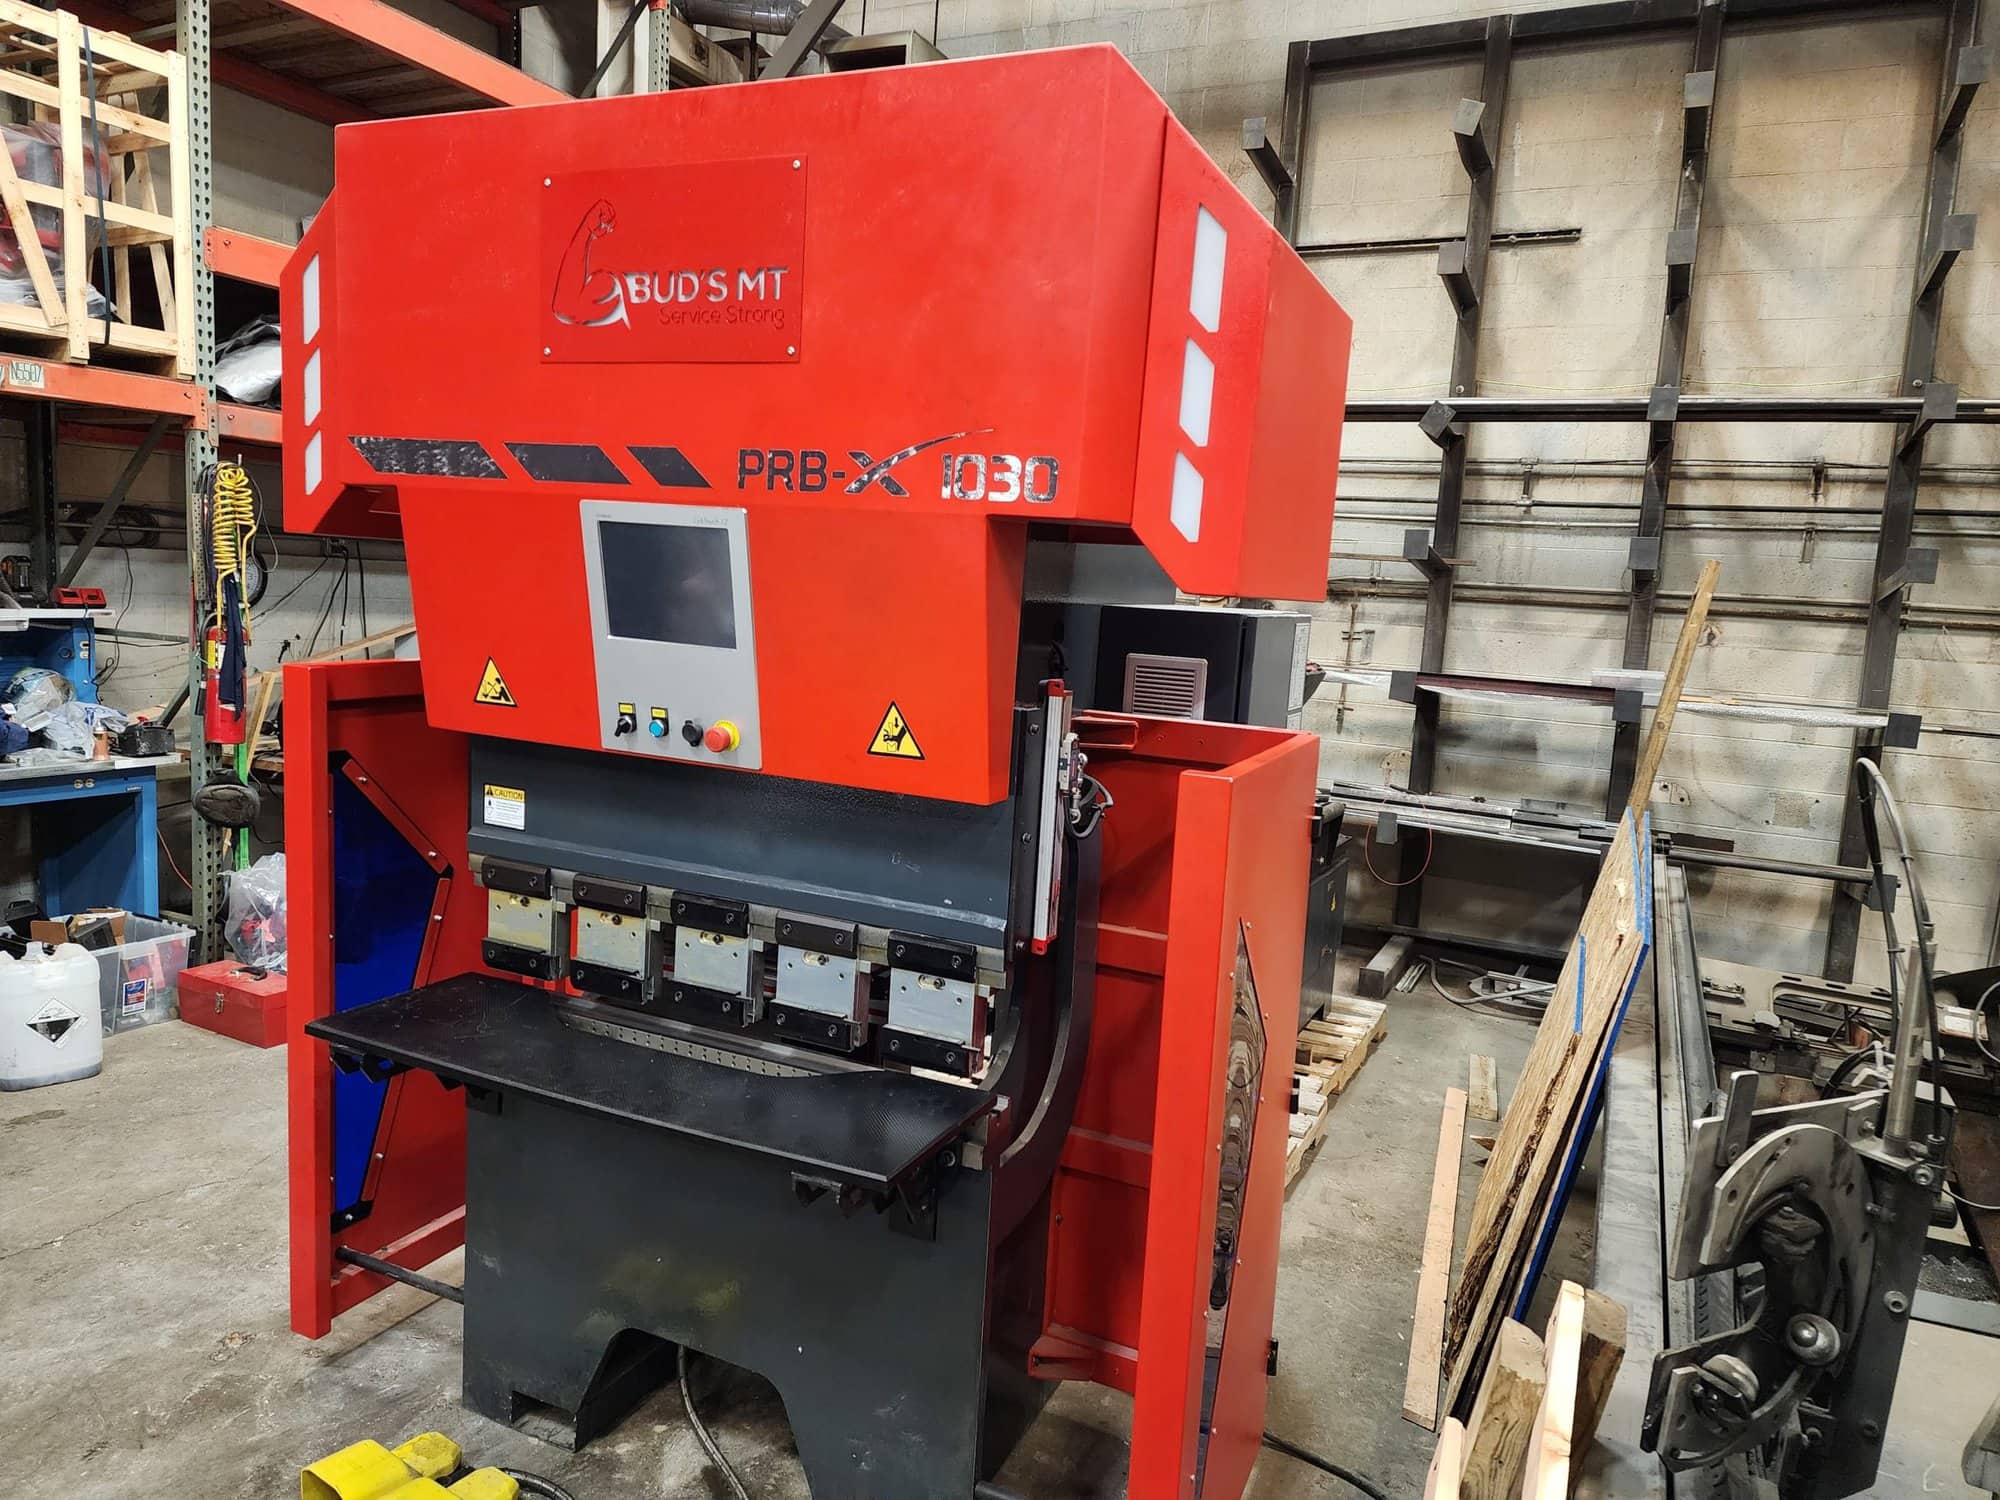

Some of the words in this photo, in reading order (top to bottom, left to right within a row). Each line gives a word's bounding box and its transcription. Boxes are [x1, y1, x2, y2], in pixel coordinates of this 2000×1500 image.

[624, 269, 728, 303] BUD'S
[737, 265, 788, 301] MT
[659, 306, 721, 325] Service
[727, 305, 785, 330] Strong
[738, 430, 975, 497] PRB-X
[941, 453, 1059, 503] 1030
[494, 788, 523, 800] CAUTION
